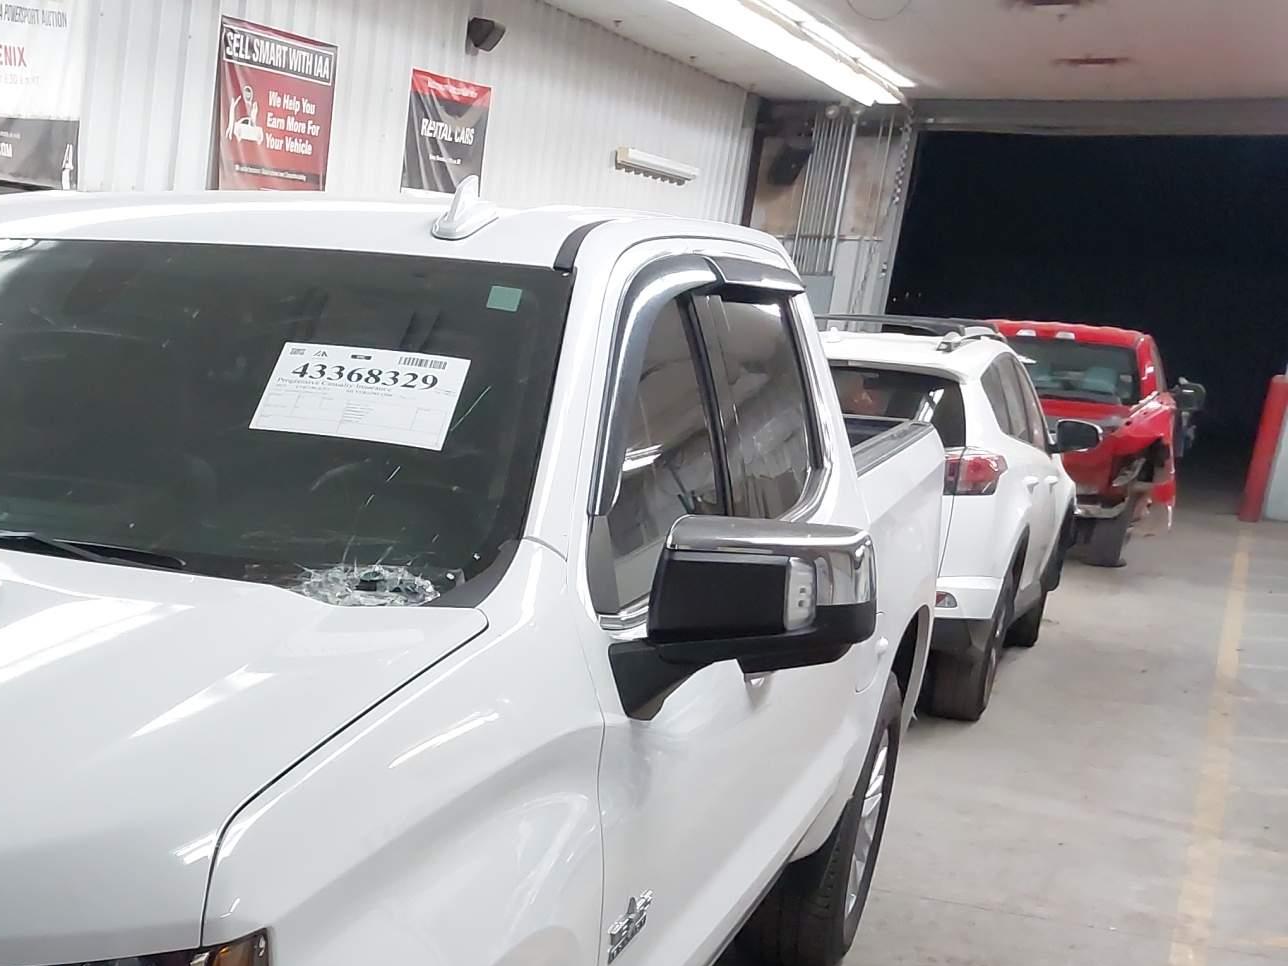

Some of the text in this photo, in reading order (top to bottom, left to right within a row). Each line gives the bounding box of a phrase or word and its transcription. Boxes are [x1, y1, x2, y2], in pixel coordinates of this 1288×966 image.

[42, 9, 67, 28] AUCTION
[226, 31, 330, 80] SELL SMART WITH IAA
[268, 90, 316, 115] We Help You
[266, 112, 321, 136] Earn More For
[420, 118, 475, 145] RENTAL CARS
[265, 132, 313, 155] Your Vehicle
[291, 362, 438, 390] 43368329
